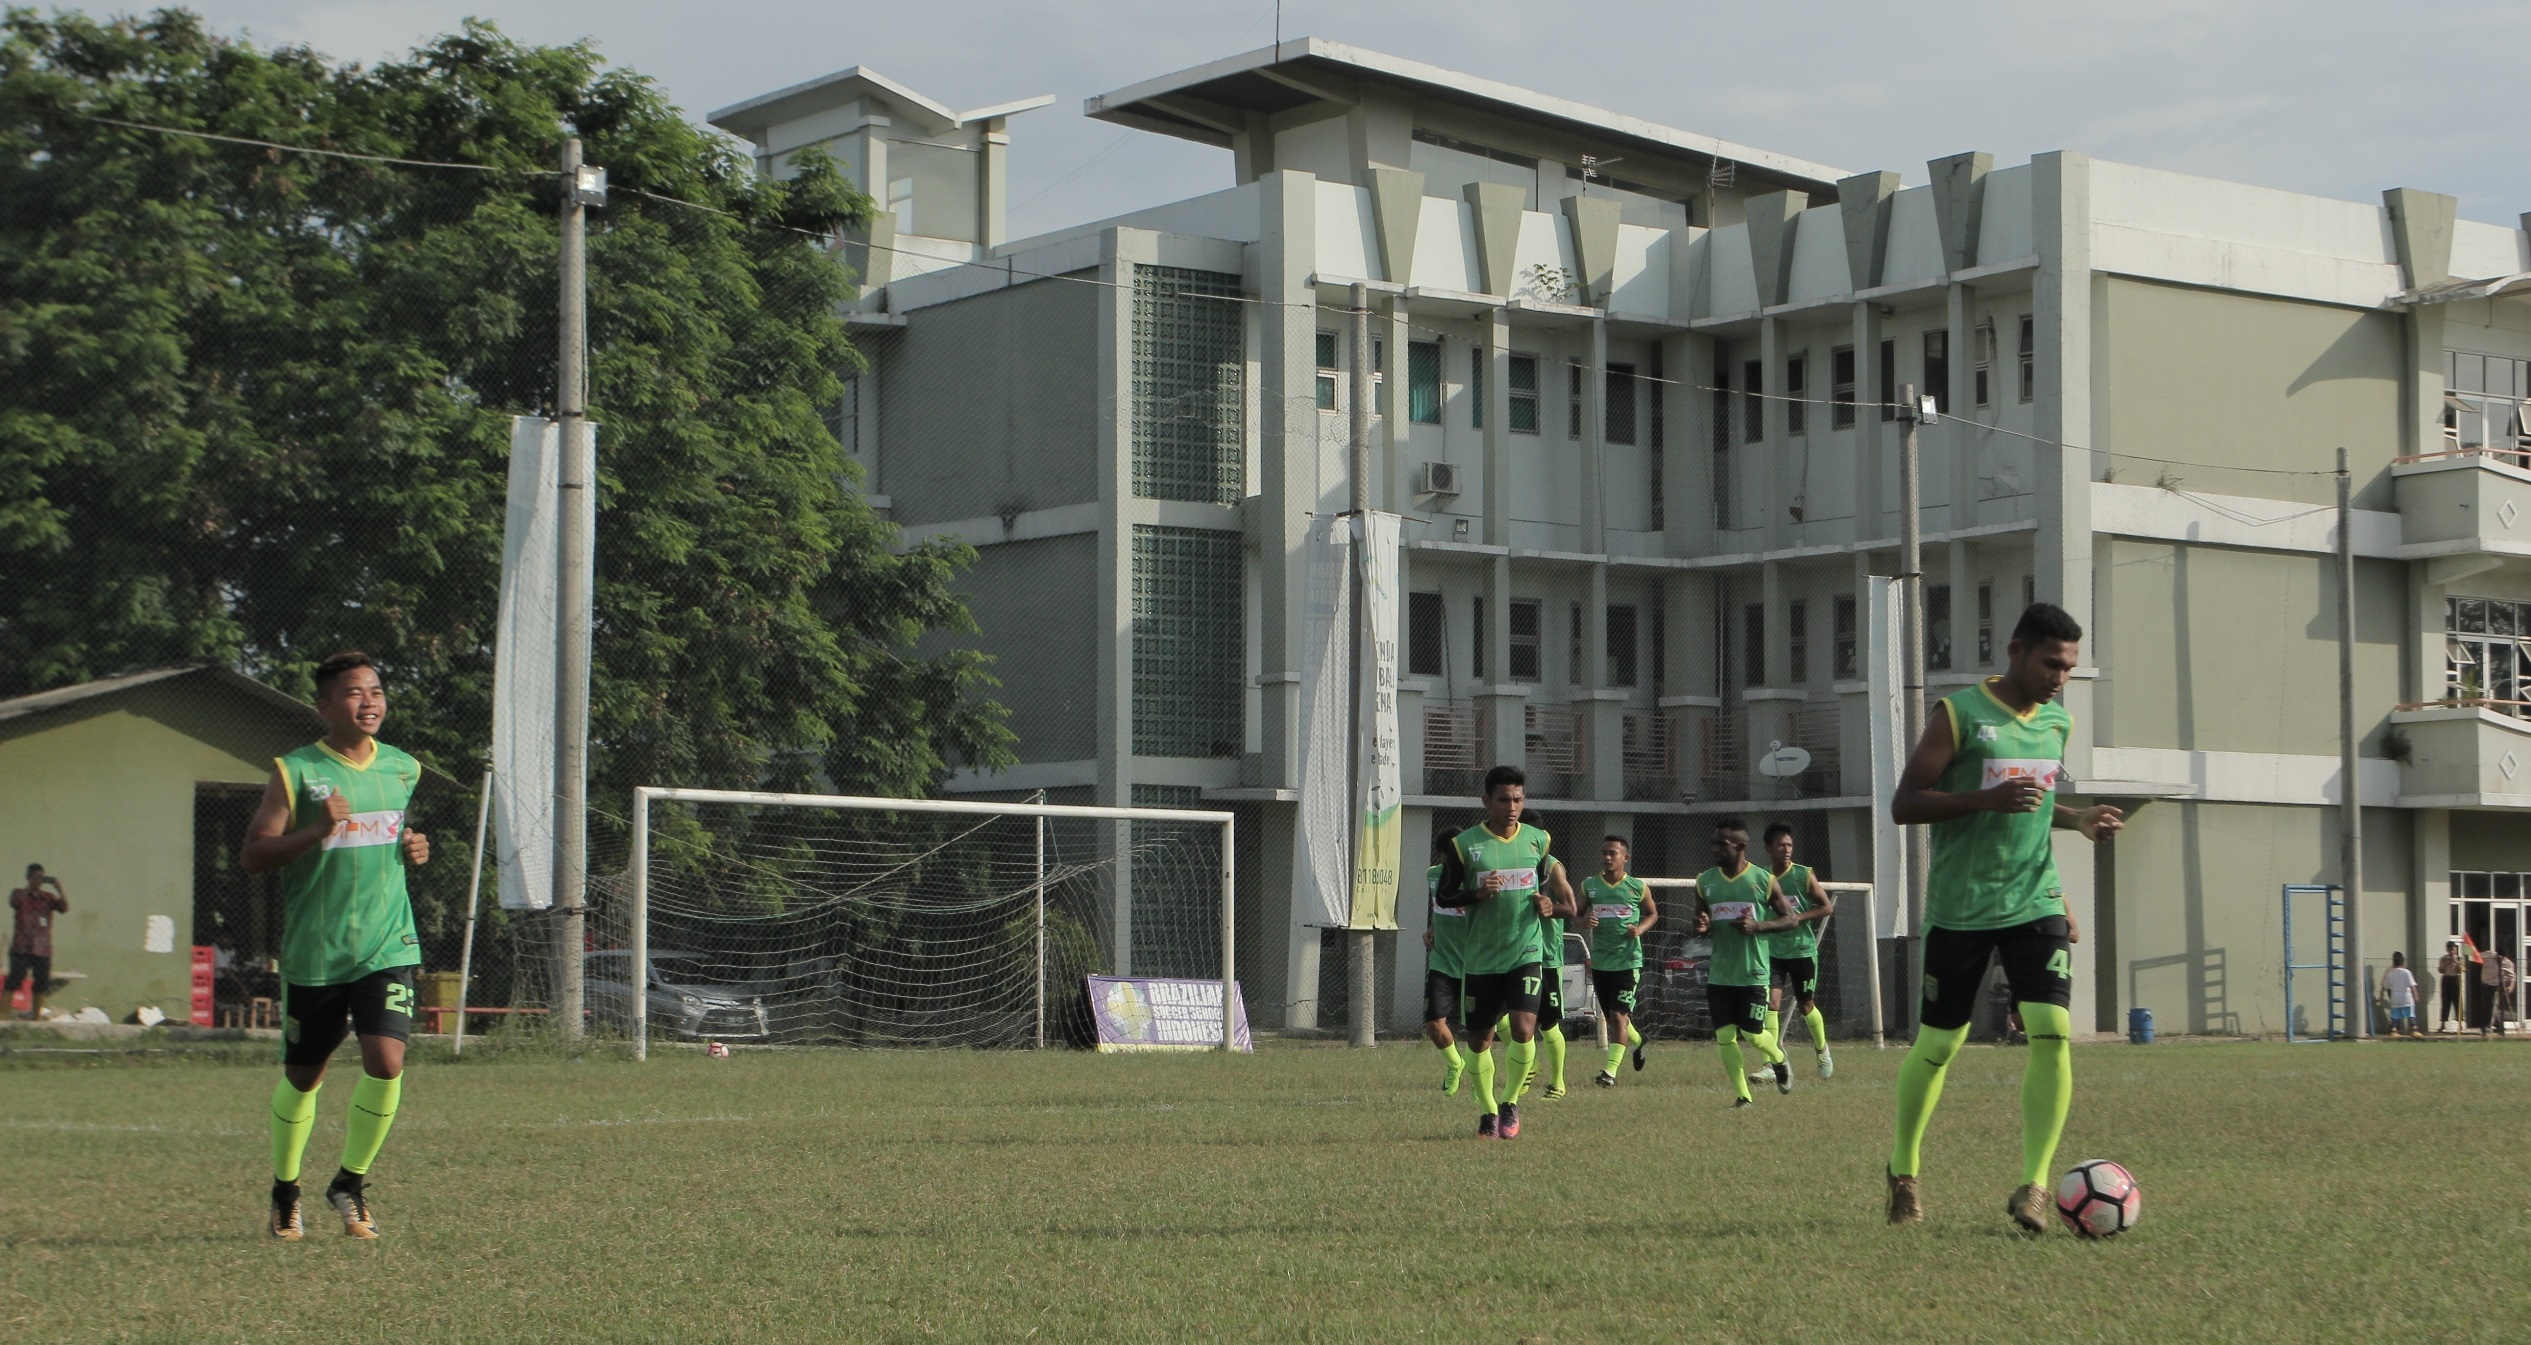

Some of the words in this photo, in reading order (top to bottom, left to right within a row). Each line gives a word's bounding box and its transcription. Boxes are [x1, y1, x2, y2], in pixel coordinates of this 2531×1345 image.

[1977, 725, 1998, 741] 44
[310, 784, 331, 801] 23
[1471, 851, 1481, 862] 17
[2046, 948, 2074, 980] 4
[1522, 976, 1541, 996] 17
[1802, 978, 1815, 993] 14
[1152, 1005, 1190, 1020] SOCCER
[1749, 1003, 1765, 1020] 18
[1155, 1020, 1223, 1042] INDONESI
